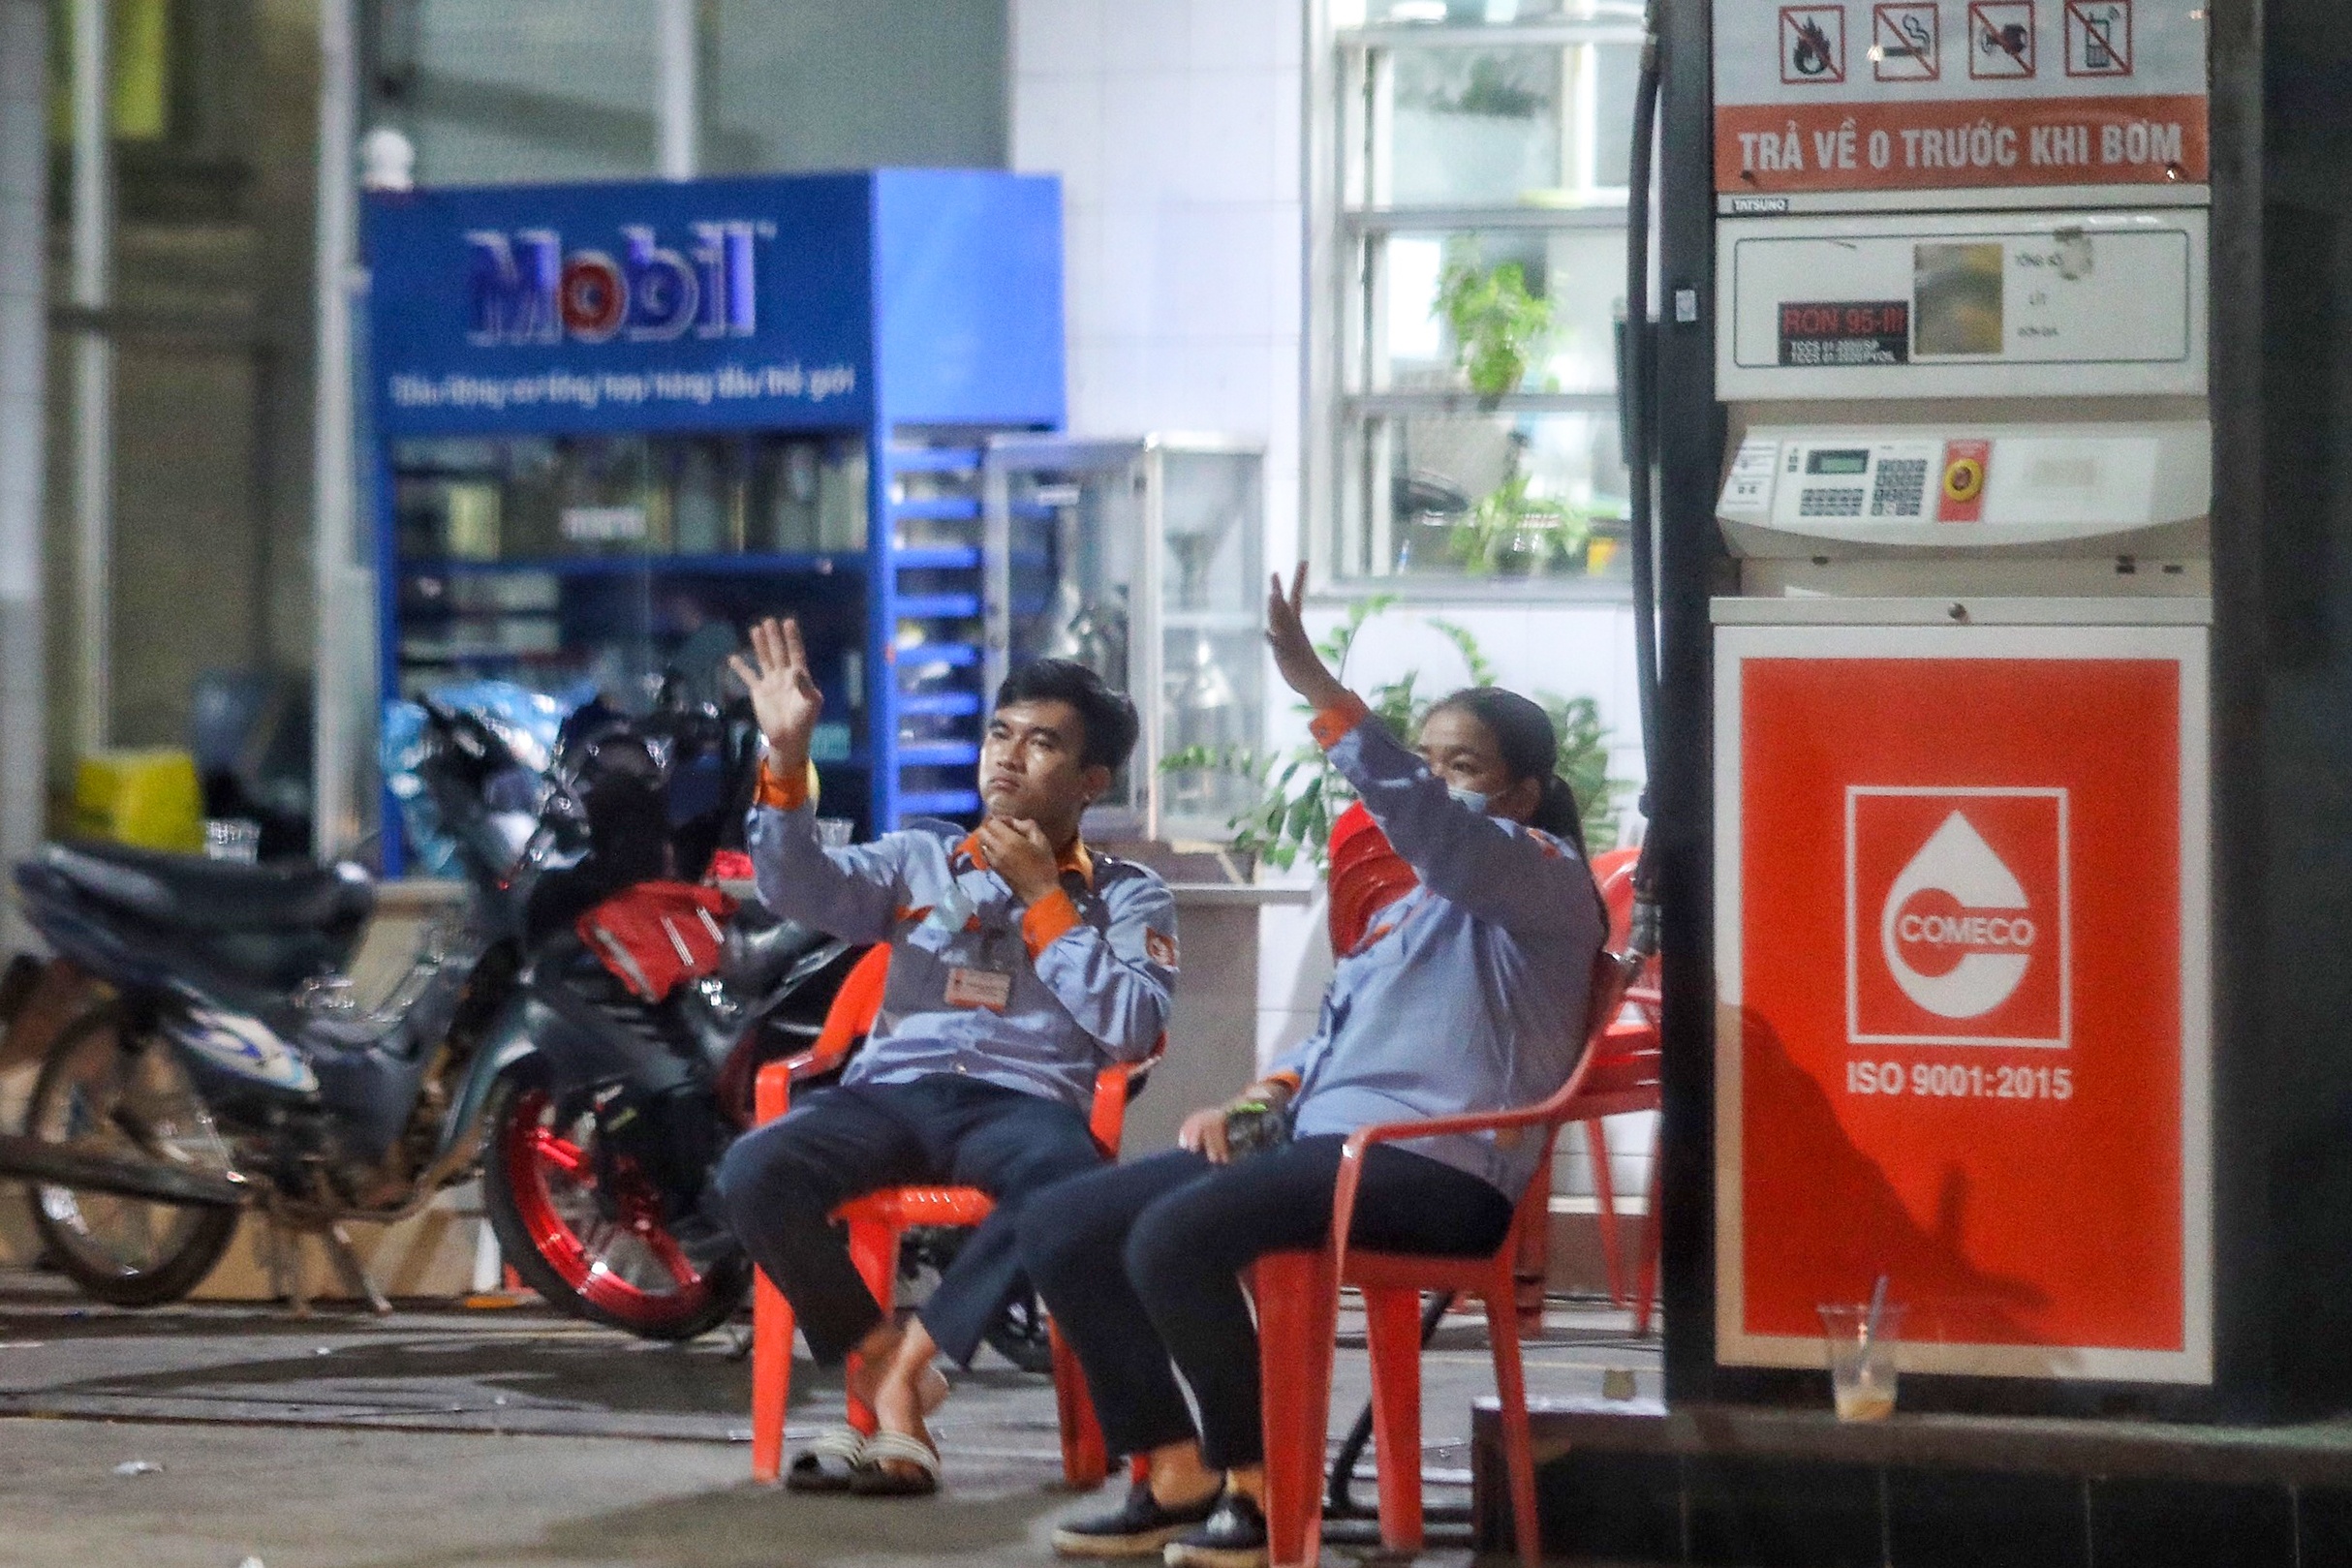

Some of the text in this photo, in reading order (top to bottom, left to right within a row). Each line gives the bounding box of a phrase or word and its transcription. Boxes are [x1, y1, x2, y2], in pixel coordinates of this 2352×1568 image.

[1738, 118, 1804, 171] TRẢ
[1813, 116, 1857, 169] VỀ
[1900, 117, 2018, 168] TRƯỚC
[2029, 125, 2089, 166] KHI
[1734, 199, 1785, 211] TATSUNO
[465, 221, 756, 346] Mobil
[1782, 308, 1840, 334] RON
[1899, 914, 2035, 947] COMECO
[1845, 1061, 2074, 1101] ISO 9001:2015
